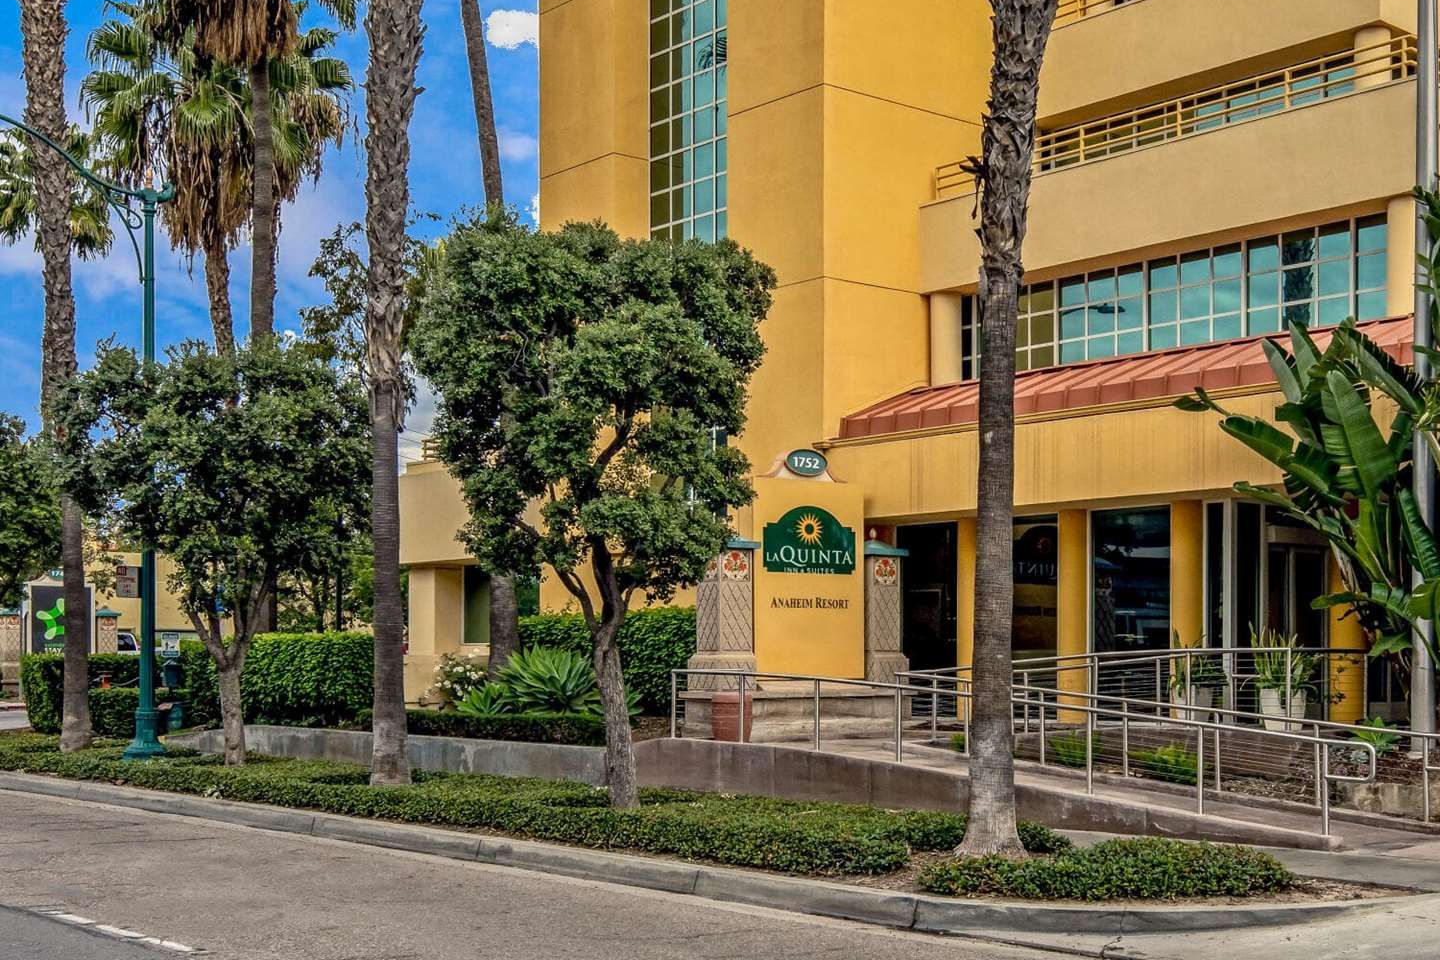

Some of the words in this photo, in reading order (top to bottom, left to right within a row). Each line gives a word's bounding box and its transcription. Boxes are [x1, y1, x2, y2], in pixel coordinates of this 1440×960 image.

[793, 456, 820, 469] 1752
[766, 551, 780, 562] LA
[780, 545, 853, 567] QUINTA
[784, 567, 798, 575] INN
[806, 567, 835, 576] SUITES
[771, 596, 813, 609] ANAHEIM
[816, 597, 850, 609] RESORT
